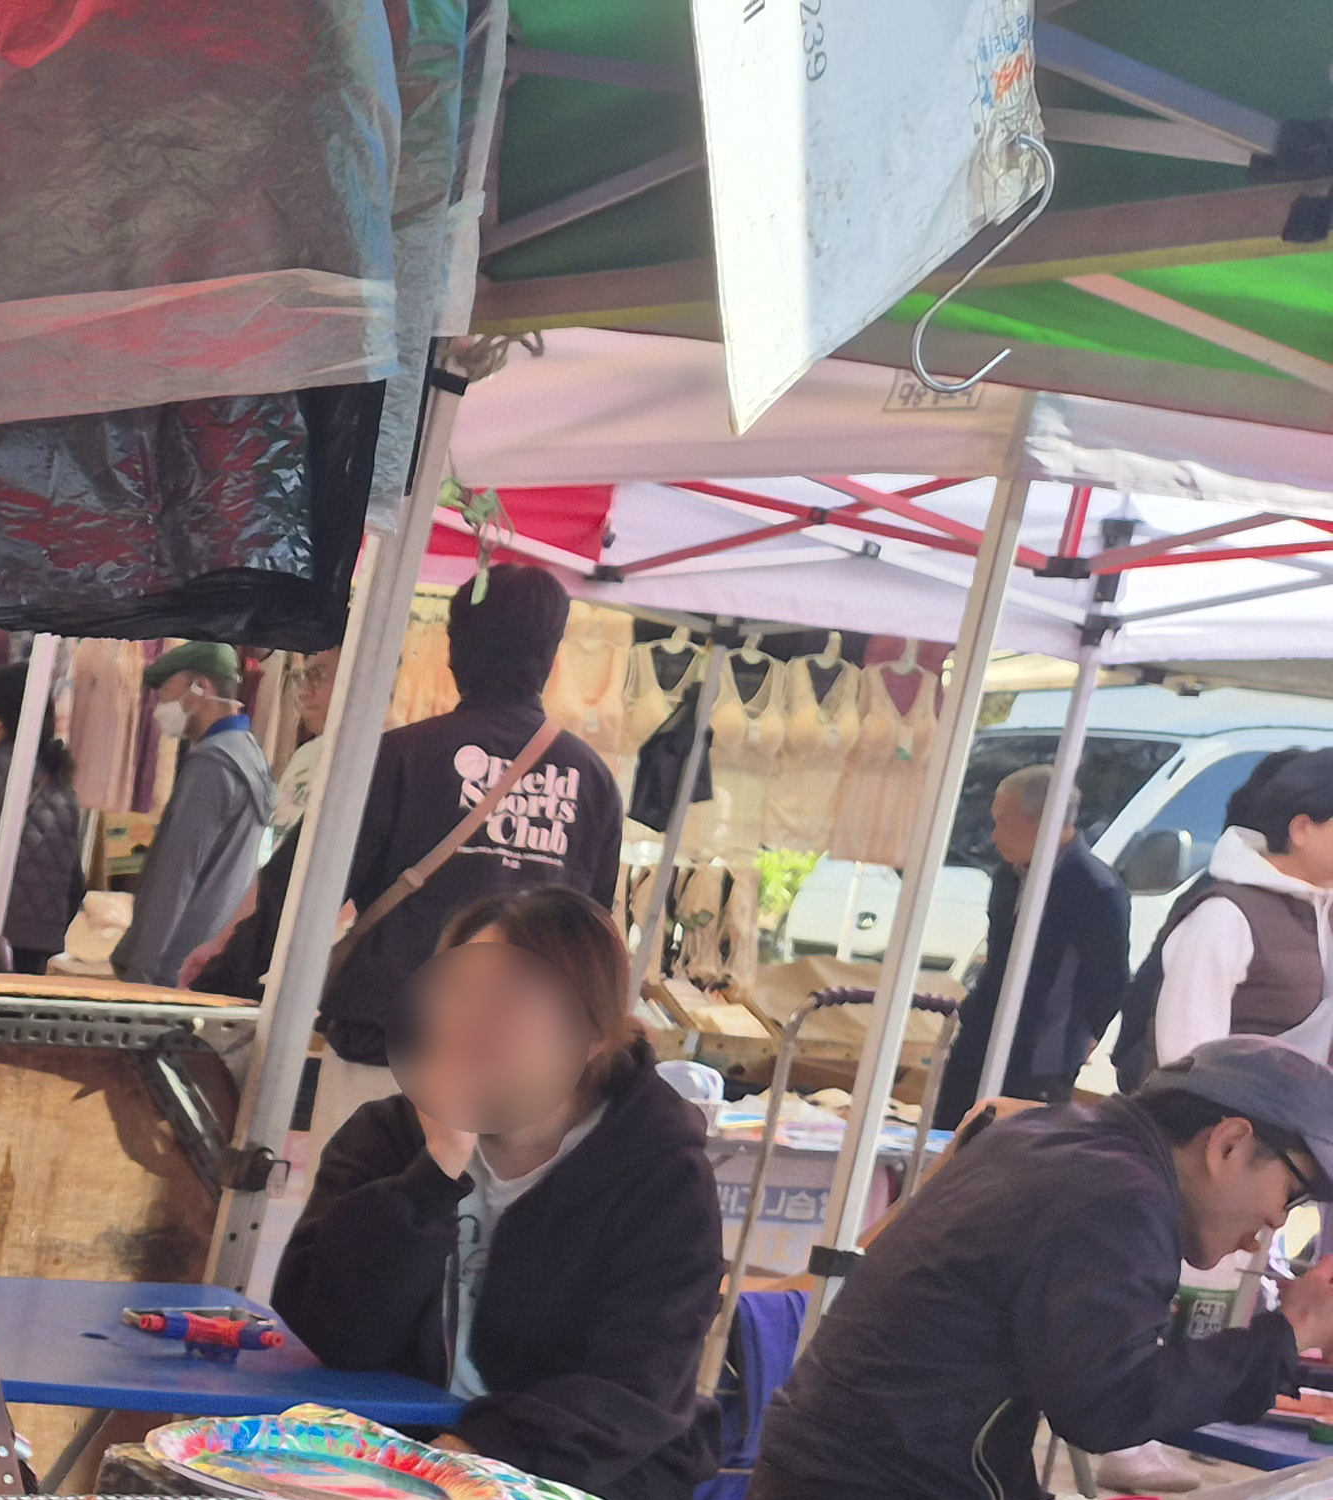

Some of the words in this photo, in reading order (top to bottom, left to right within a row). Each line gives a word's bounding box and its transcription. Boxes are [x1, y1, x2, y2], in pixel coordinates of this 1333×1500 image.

[459, 778, 577, 823] Sorts
[484, 756, 580, 801] Feld
[486, 813, 568, 855] Club
